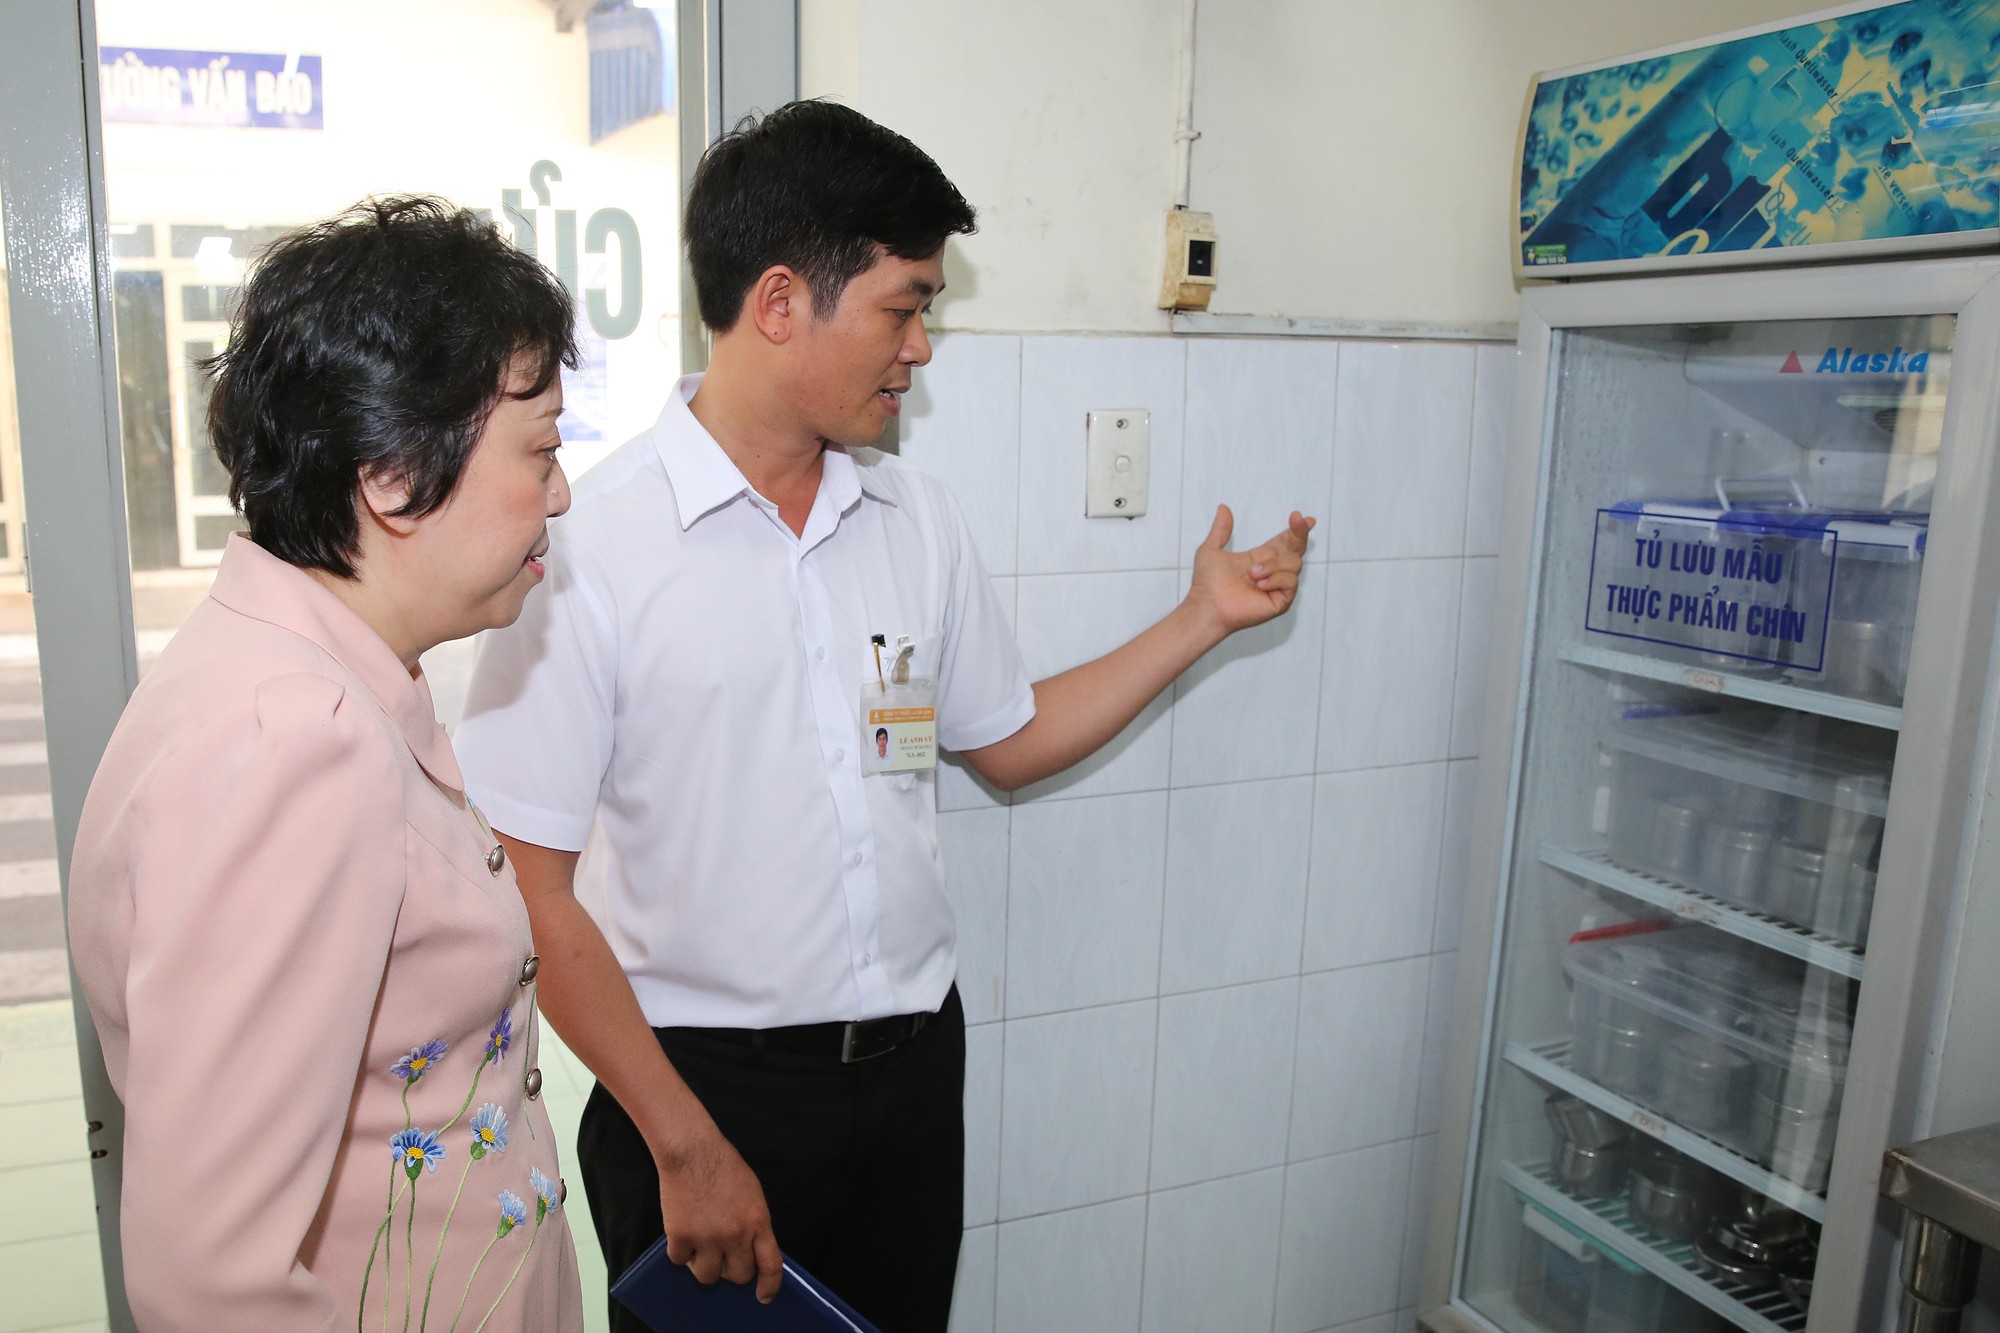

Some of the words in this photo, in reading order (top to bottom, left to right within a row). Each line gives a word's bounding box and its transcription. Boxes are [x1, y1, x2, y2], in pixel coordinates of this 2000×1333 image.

[1795, 49, 1838, 99] Quellwasser
[1785, 147, 1835, 201] Quellwasser
[1815, 345, 1930, 374] Alaska
[1635, 529, 1663, 570] TỦ
[1669, 539, 1716, 576] LƯU
[1722, 537, 1785, 585] MẪU
[1606, 583, 1662, 625] THỰC
[1667, 584, 1739, 633] PHẨM
[1745, 602, 1806, 644] CHÍN
